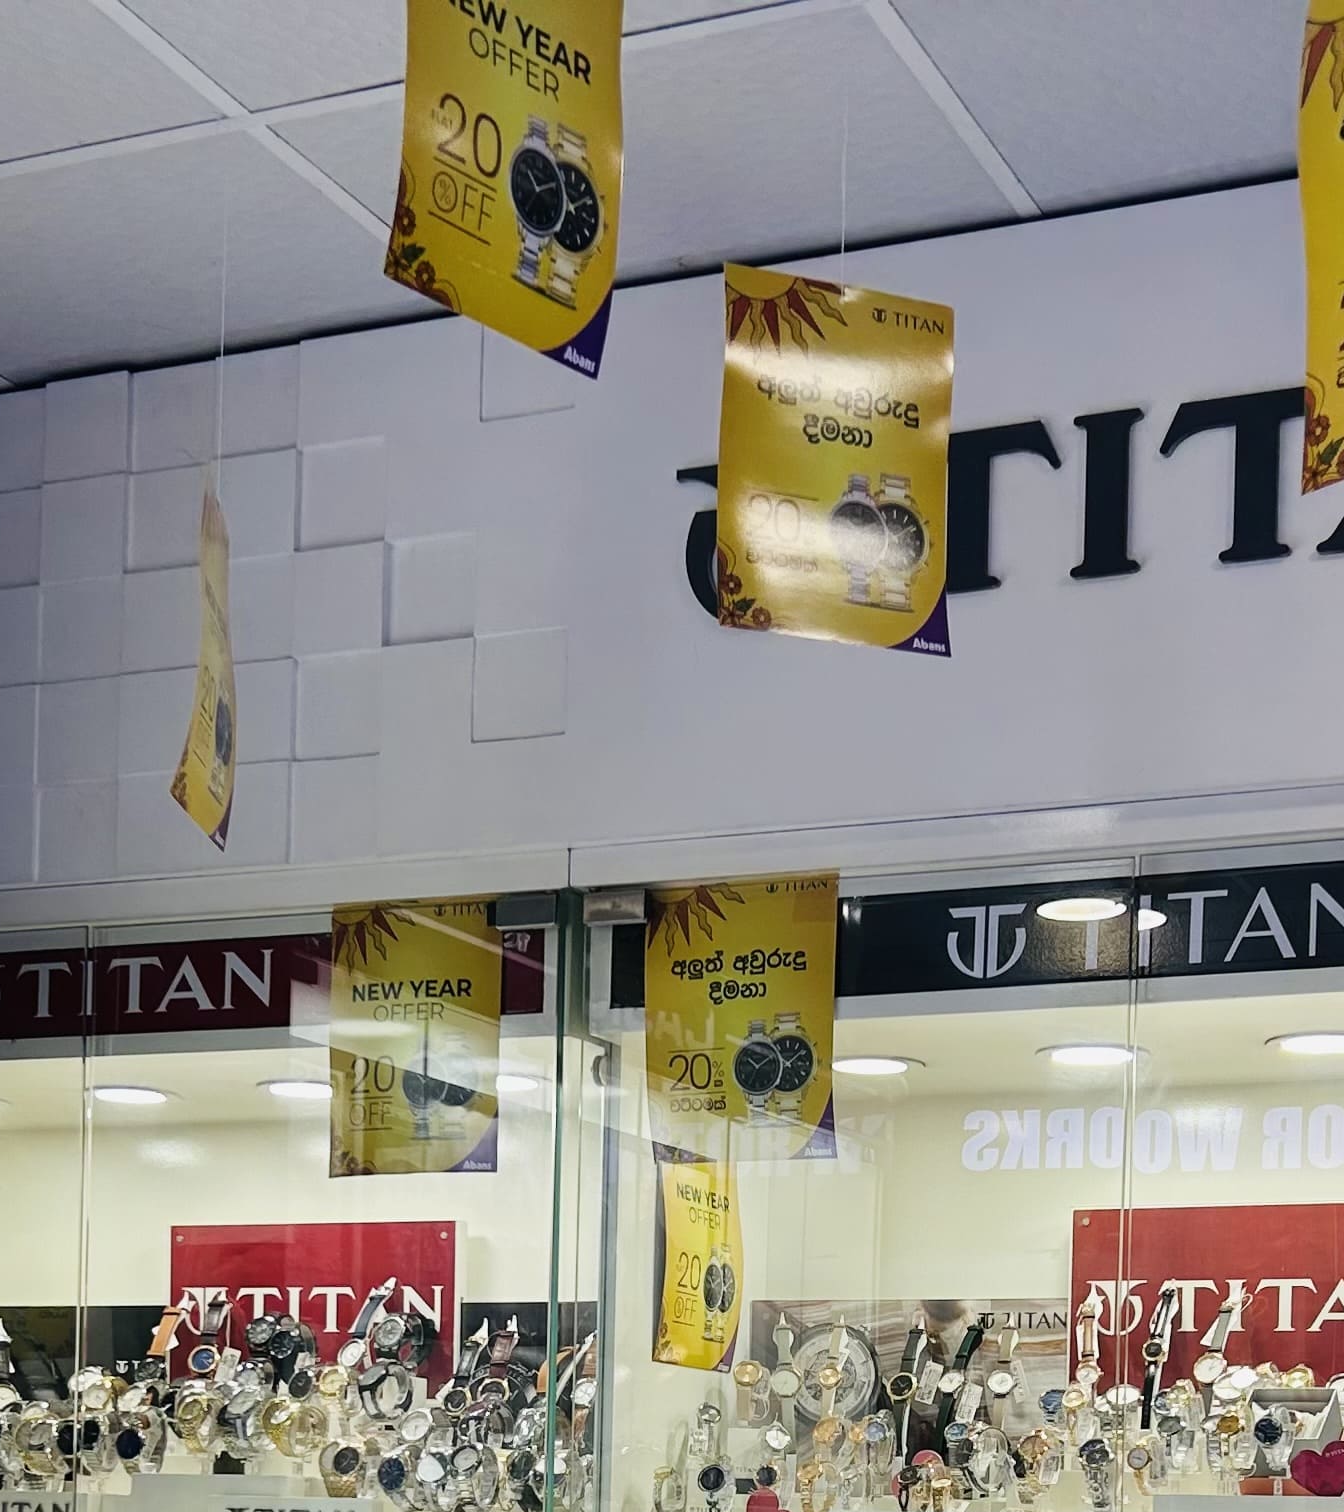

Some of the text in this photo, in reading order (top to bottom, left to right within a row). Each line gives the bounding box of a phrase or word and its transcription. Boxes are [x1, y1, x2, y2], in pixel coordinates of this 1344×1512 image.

[468, 28, 560, 102] OFFER
[514, 16, 591, 85] YEAR
[438, 92, 502, 179] 20
[894, 311, 945, 336] TITAN
[564, 344, 595, 373] Abans
[803, 414, 873, 449] දීමනා
[912, 636, 947, 653] Abans
[16, 949, 274, 1018] TITAN
[352, 978, 472, 1003] NEW YEAR
[373, 1001, 445, 1022] OFFER
[349, 1054, 395, 1095] 20
[463, 1158, 492, 1171] Abans
[676, 1183, 729, 1213] NEW YEAR
[689, 1205, 721, 1229] OFFER
[677, 1251, 702, 1290] 20
